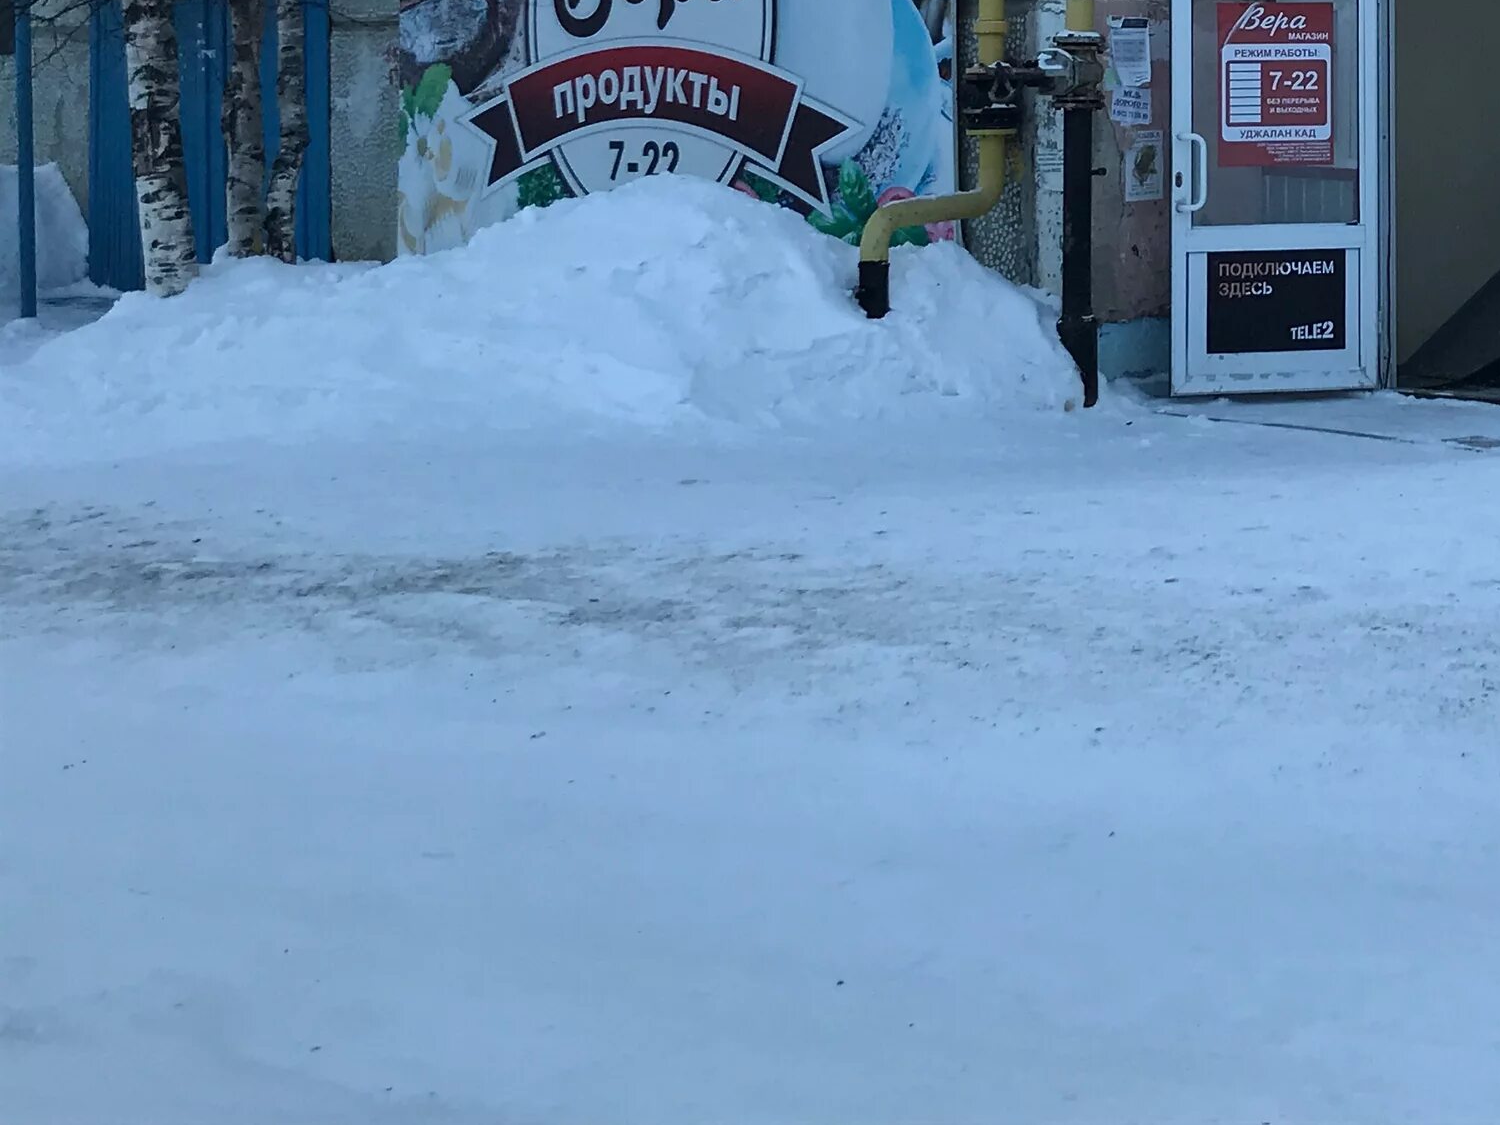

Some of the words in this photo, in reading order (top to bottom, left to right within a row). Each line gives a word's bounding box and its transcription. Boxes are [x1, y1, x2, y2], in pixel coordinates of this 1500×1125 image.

[1230, 2, 1307, 39] Вера
[1288, 31, 1329, 41] МАГАЗИН
[1234, 48, 1272, 58] РЕЖИМ
[1268, 70, 1319, 92] 7-22
[552, 65, 741, 124] продукты
[1266, 97, 1281, 105] БЕЗ
[1281, 97, 1320, 105] ПЕРЕРЫВА
[1276, 106, 1317, 114] ВЫХОДНЫХ
[1239, 128, 1292, 140] УДЖАЛАН
[1295, 127, 1317, 139] КАД
[608, 140, 681, 181] 7-22
[1218, 260, 1335, 279] ПОДКЛЮЧАЕМ
[1218, 280, 1273, 299] ЗДЕСЬ
[1290, 320, 1335, 340] TELE2
